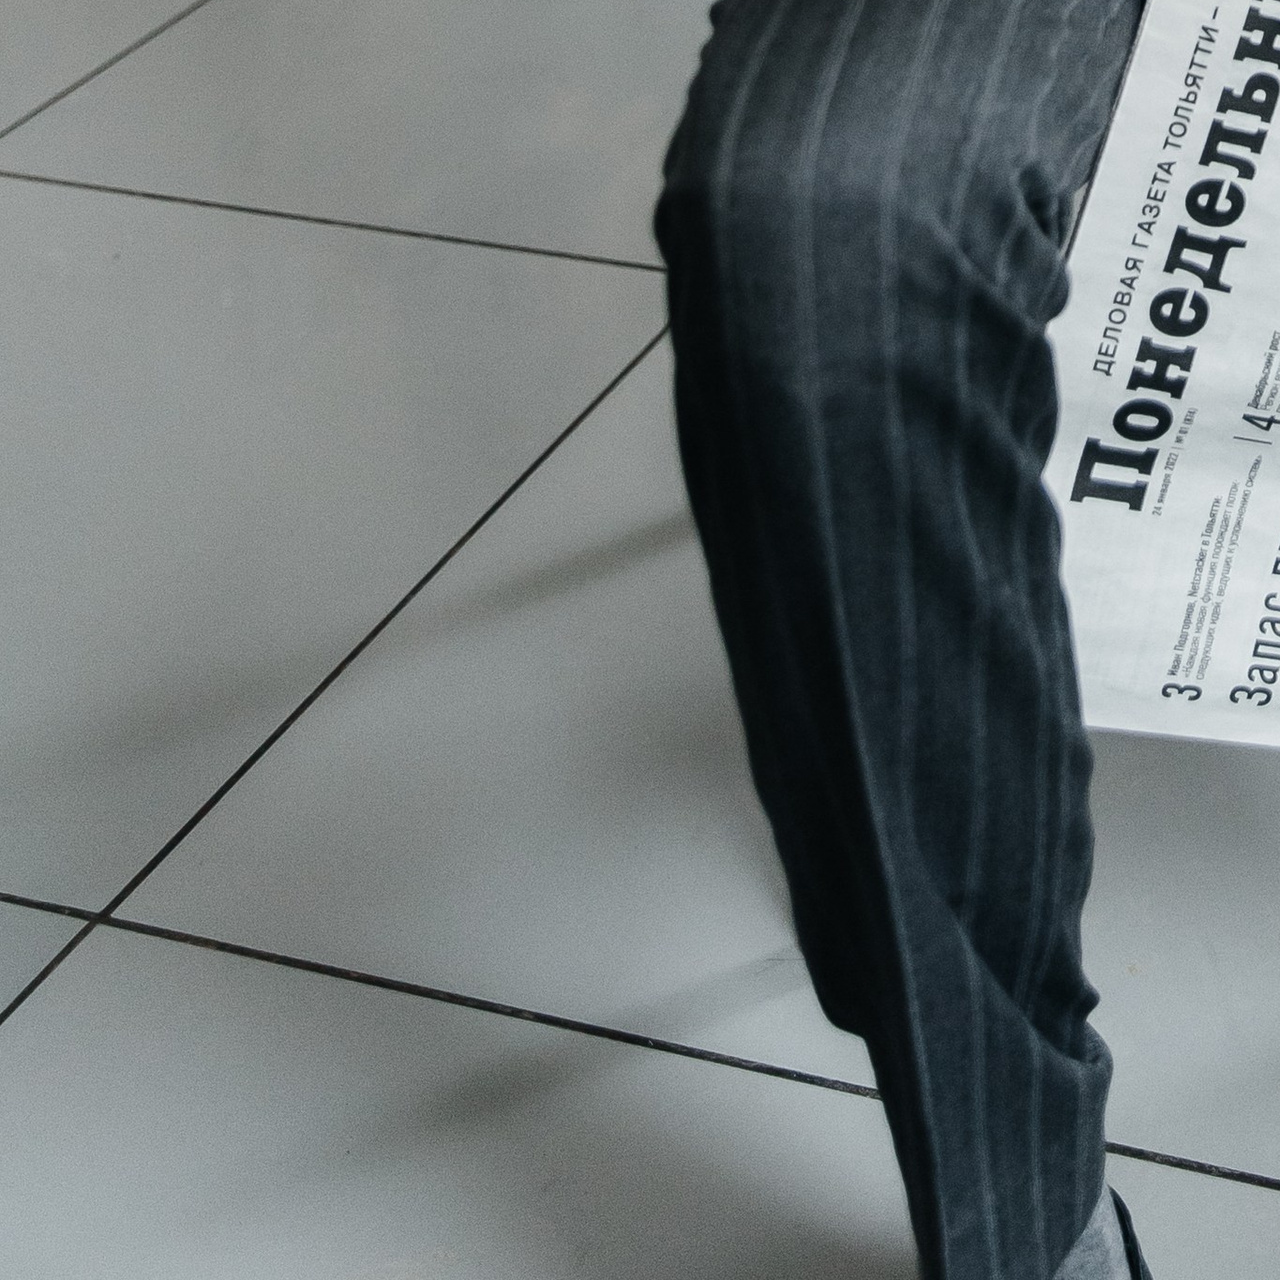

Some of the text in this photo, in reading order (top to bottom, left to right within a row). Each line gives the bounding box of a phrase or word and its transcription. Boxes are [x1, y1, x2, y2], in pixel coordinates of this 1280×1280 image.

[1092, 25, 1219, 377] ДЕЛОВАЯ ГАЗЕТА ТОЛЬЯТТИ
[1259, 383, 1279, 412] Регион
[1242, 414, 1280, 431] 4
[1163, 452, 1179, 472] 2022
[1156, 473, 1172, 504] января
[1151, 506, 1163, 517] 24
[1200, 497, 1222, 538] Тольятти:
[1201, 539, 1210, 547] в
[1211, 509, 1232, 560] порождает
[1187, 547, 1208, 598] Netcracker
[1195, 627, 1216, 681] следующих
[1216, 556, 1233, 597] ведущих
[1228, 489, 1252, 547] усложнению
[1199, 561, 1218, 604] функция
[1194, 605, 1208, 634] новая
[1166, 653, 1182, 676] Иван
[1181, 635, 1201, 678] «Каждая
[1162, 684, 1201, 700] 3
